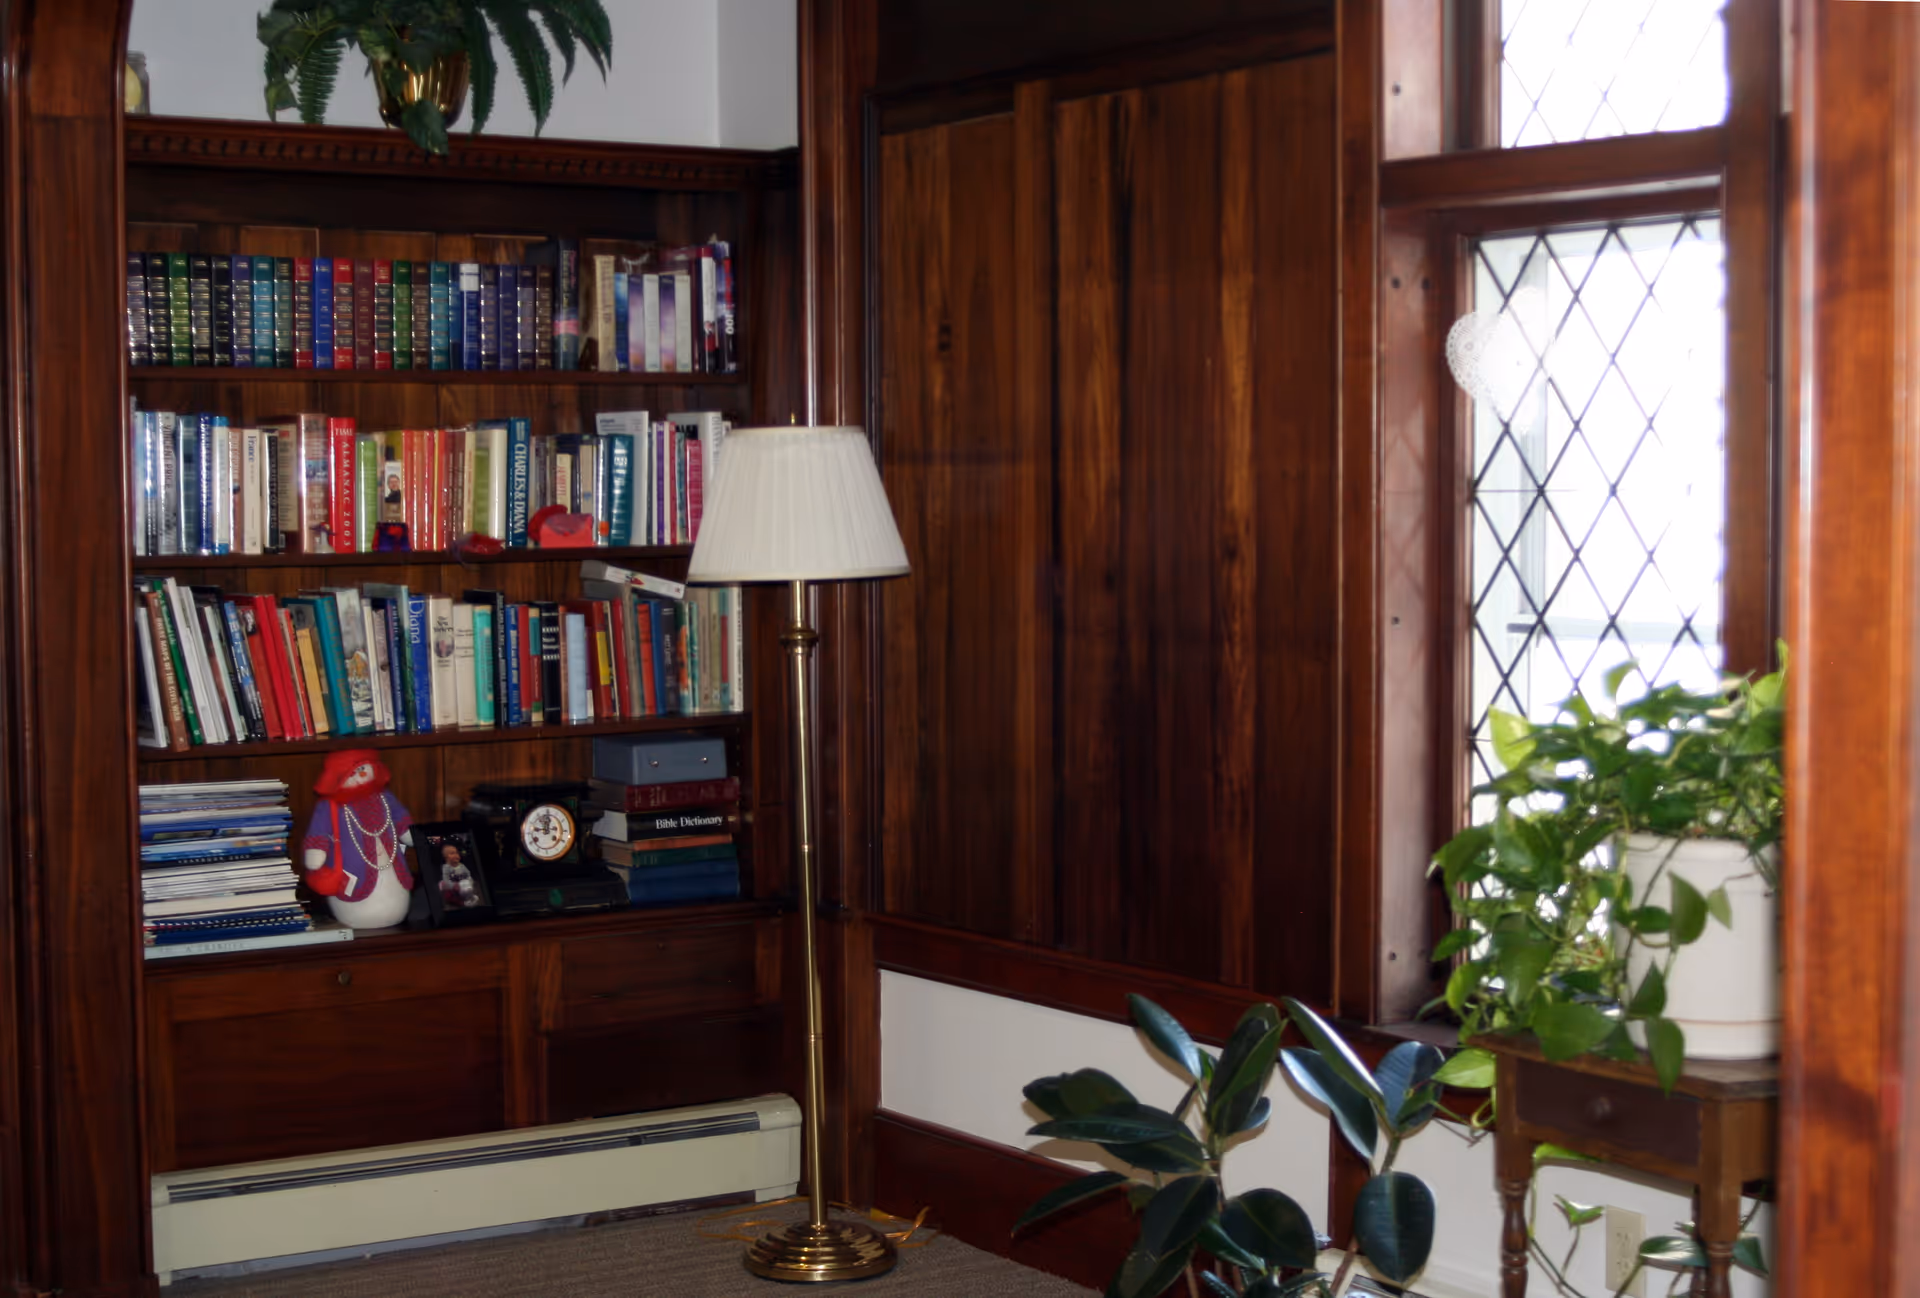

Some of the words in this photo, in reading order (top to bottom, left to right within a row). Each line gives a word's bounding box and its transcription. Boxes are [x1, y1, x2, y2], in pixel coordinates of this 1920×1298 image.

[163, 424, 172, 460] VINCENT
[335, 428, 353, 437] TIME
[247, 436, 257, 462] France
[164, 463, 174, 489] PRICE
[342, 441, 351, 504] ALMANAC
[513, 442, 528, 491] CHARLES
[514, 490, 526, 500] &
[514, 500, 526, 534] DIANA
[343, 511, 352, 547] 2003
[408, 600, 425, 644] Diana
[160, 640, 171, 661] MAPS
[168, 634, 176, 645] Life
[166, 672, 175, 685] THE
[168, 685, 179, 704] CIVIL
[172, 704, 182, 722] WAR
[656, 818, 678, 829] Bible
[680, 815, 723, 827] Dictionary
